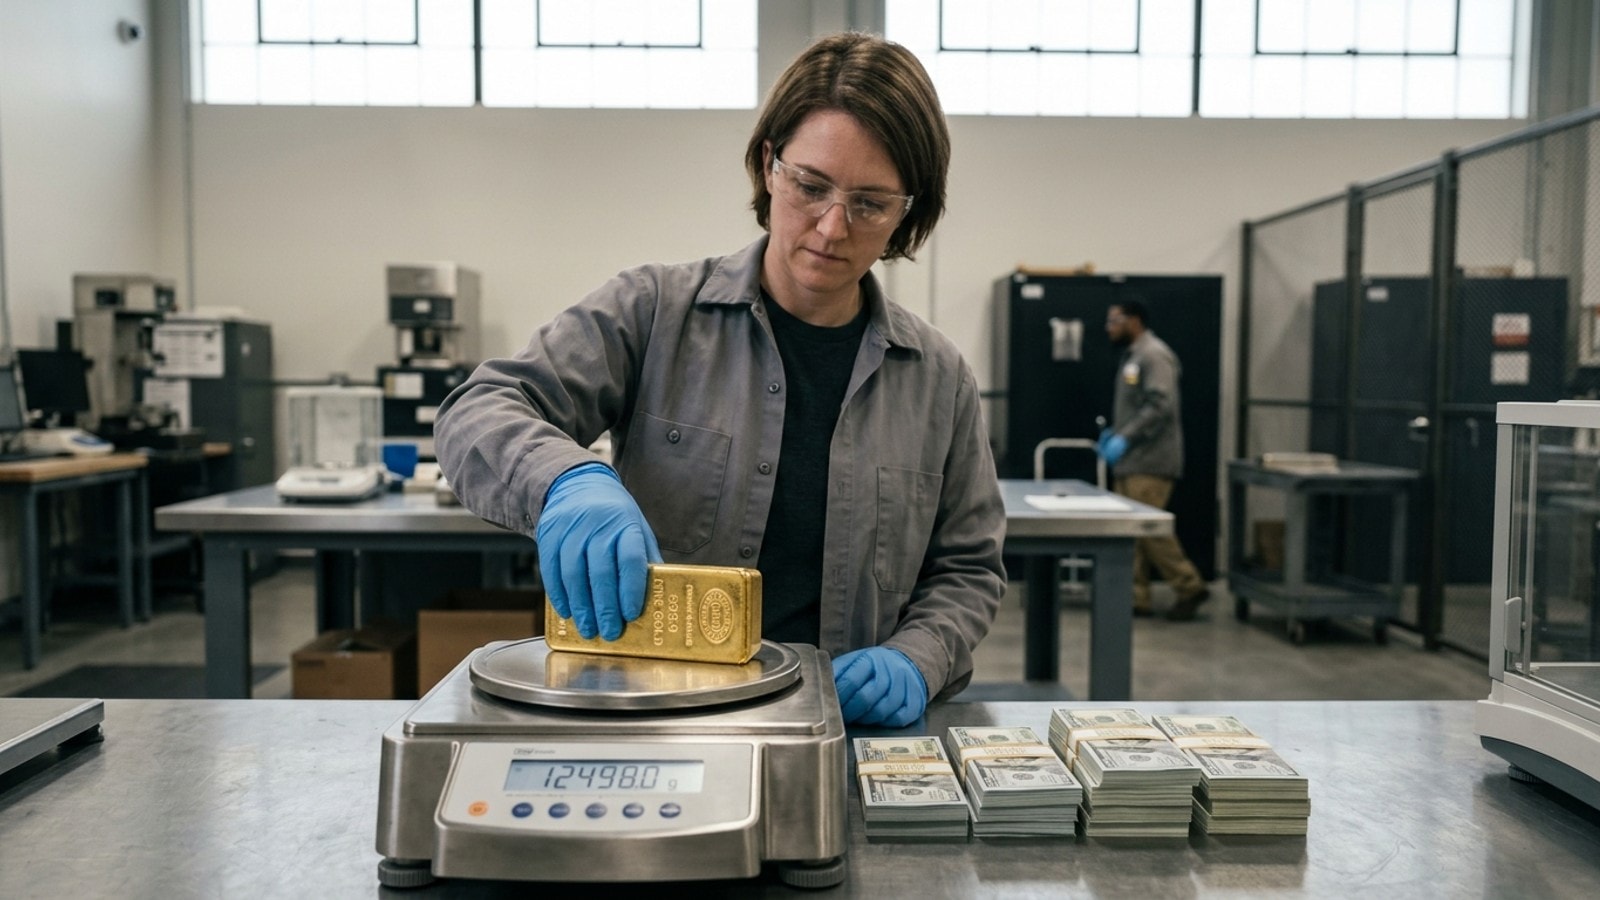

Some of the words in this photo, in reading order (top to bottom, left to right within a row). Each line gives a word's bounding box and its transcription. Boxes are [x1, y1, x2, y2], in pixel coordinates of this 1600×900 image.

[653, 610, 664, 646] GOLD
[544, 765, 660, 789] 12498.0
[668, 778, 678, 791] g
